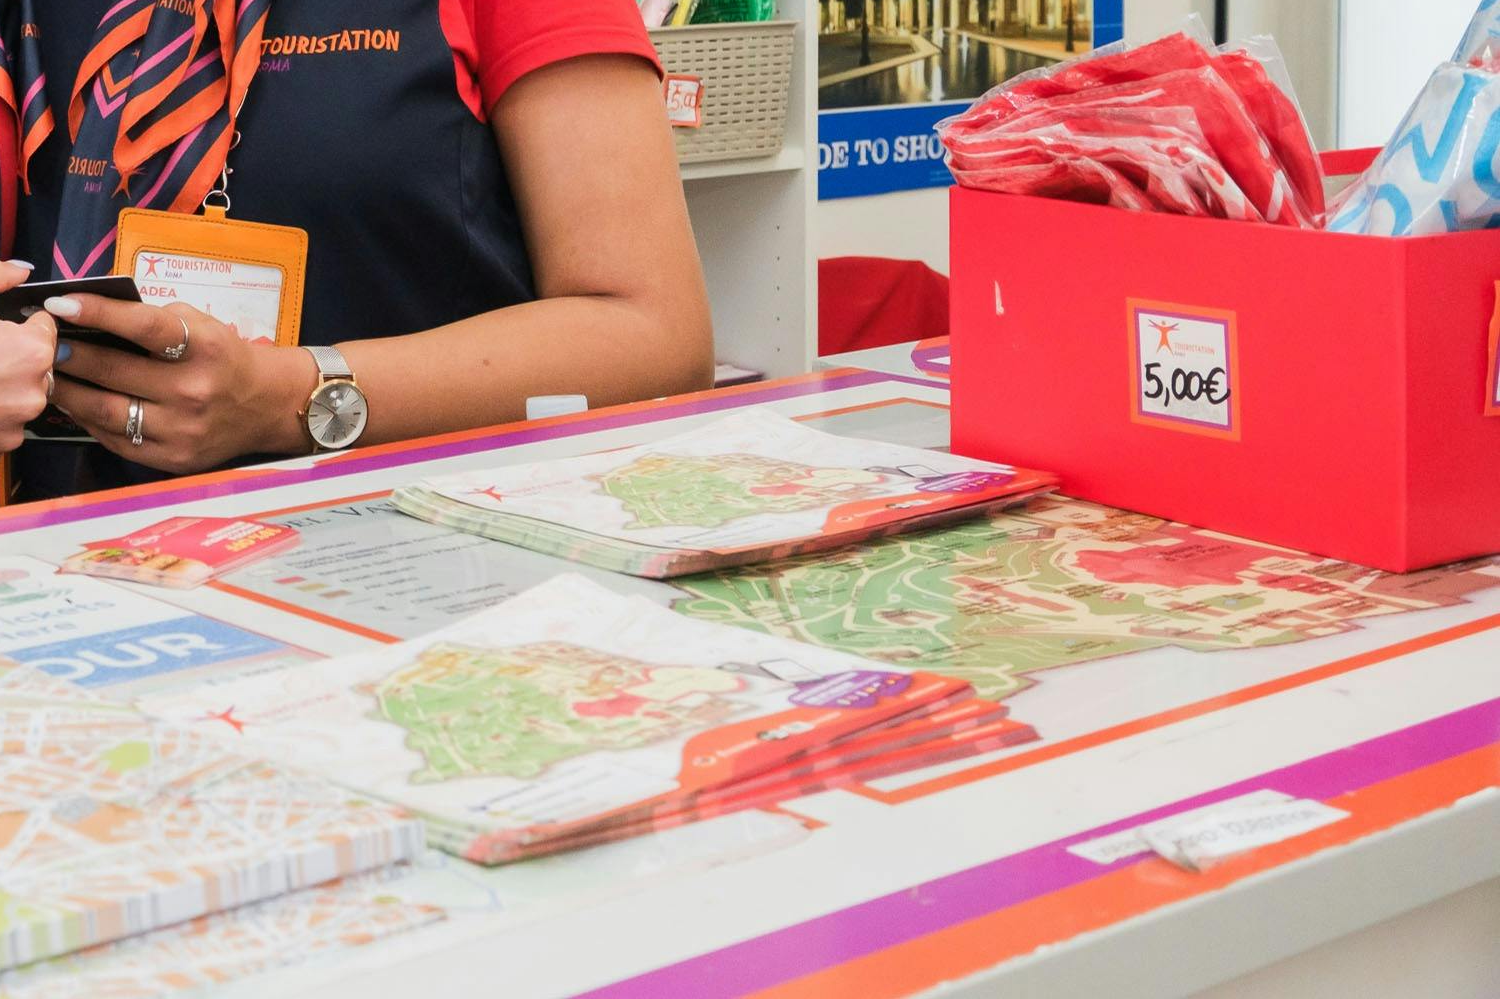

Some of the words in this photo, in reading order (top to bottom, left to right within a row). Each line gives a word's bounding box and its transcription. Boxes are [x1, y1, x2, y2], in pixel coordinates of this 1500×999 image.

[260, 28, 400, 56] TOURISTATION
[258, 58, 291, 73] OMA
[857, 139, 889, 166] TO
[894, 136, 945, 163] SHO
[166, 258, 232, 275] TOURISTATION
[139, 286, 177, 299] ADEA
[1144, 362, 1231, 407] 5,00€
